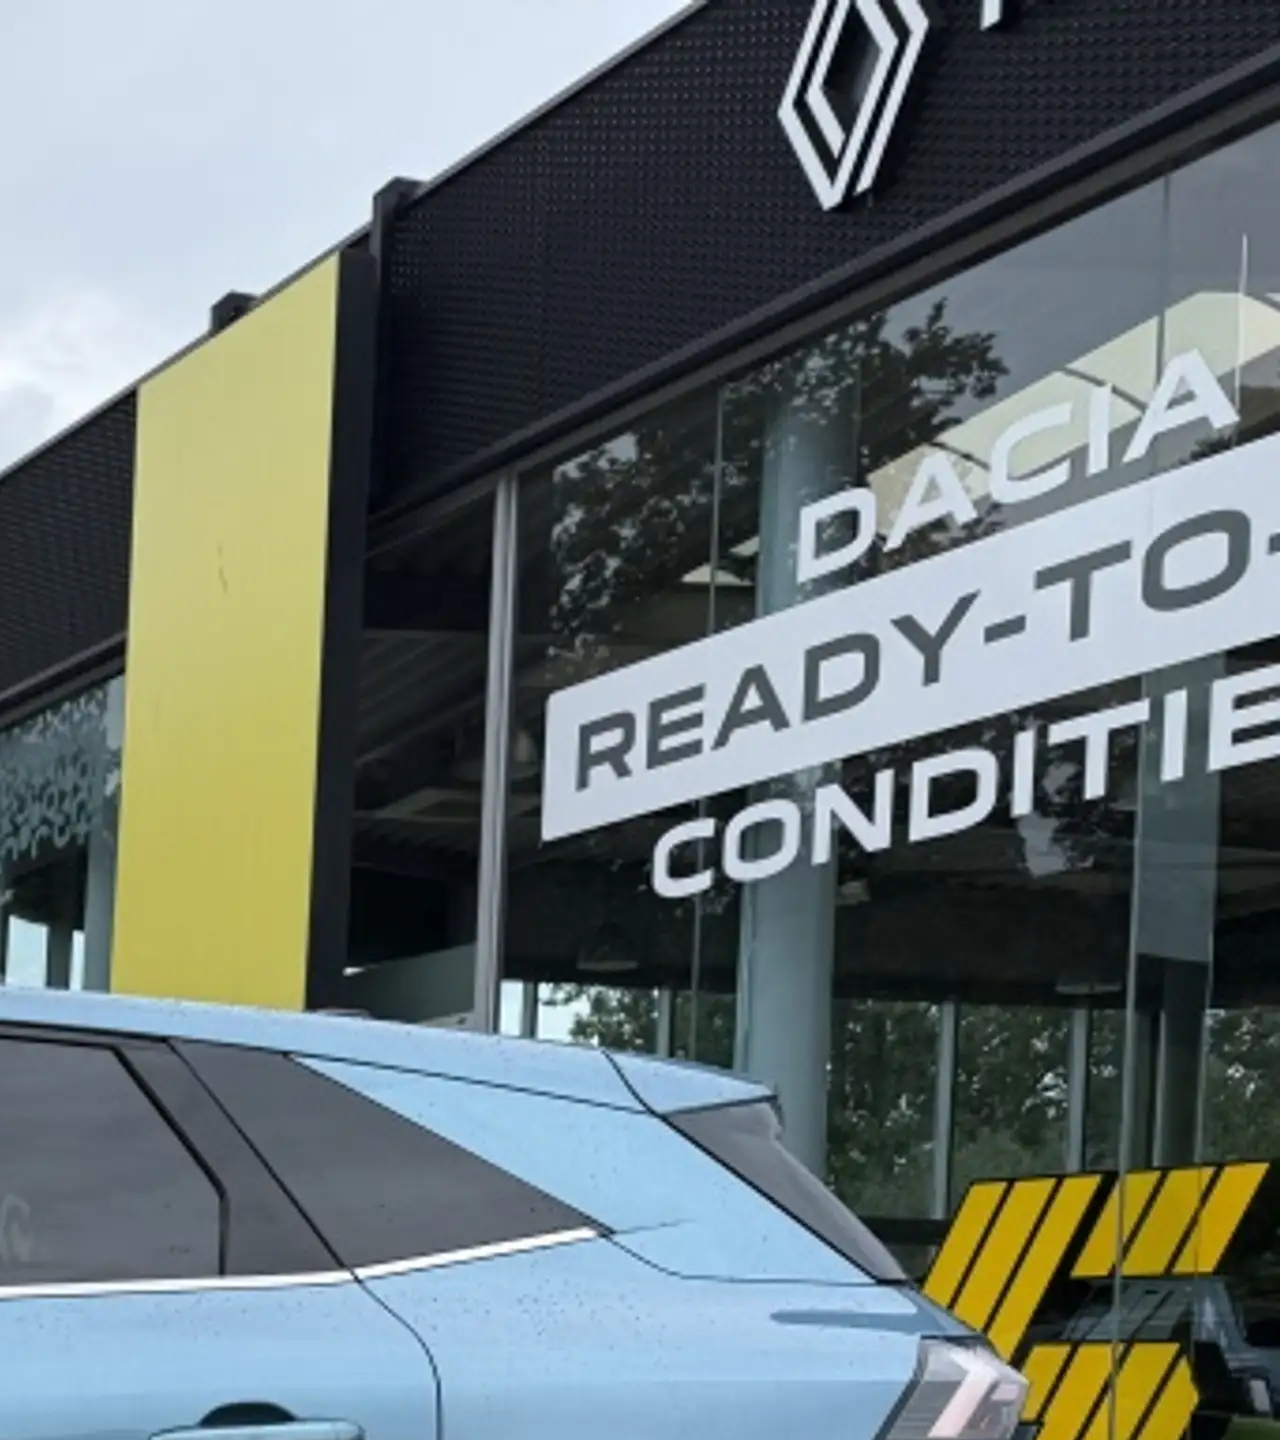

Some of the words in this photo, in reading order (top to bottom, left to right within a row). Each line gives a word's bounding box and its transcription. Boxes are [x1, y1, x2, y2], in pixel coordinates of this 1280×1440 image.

[797, 348, 1241, 584] DACIA
[575, 508, 1280, 791] READY-TO
[649, 662, 1280, 899] CONDITIE
